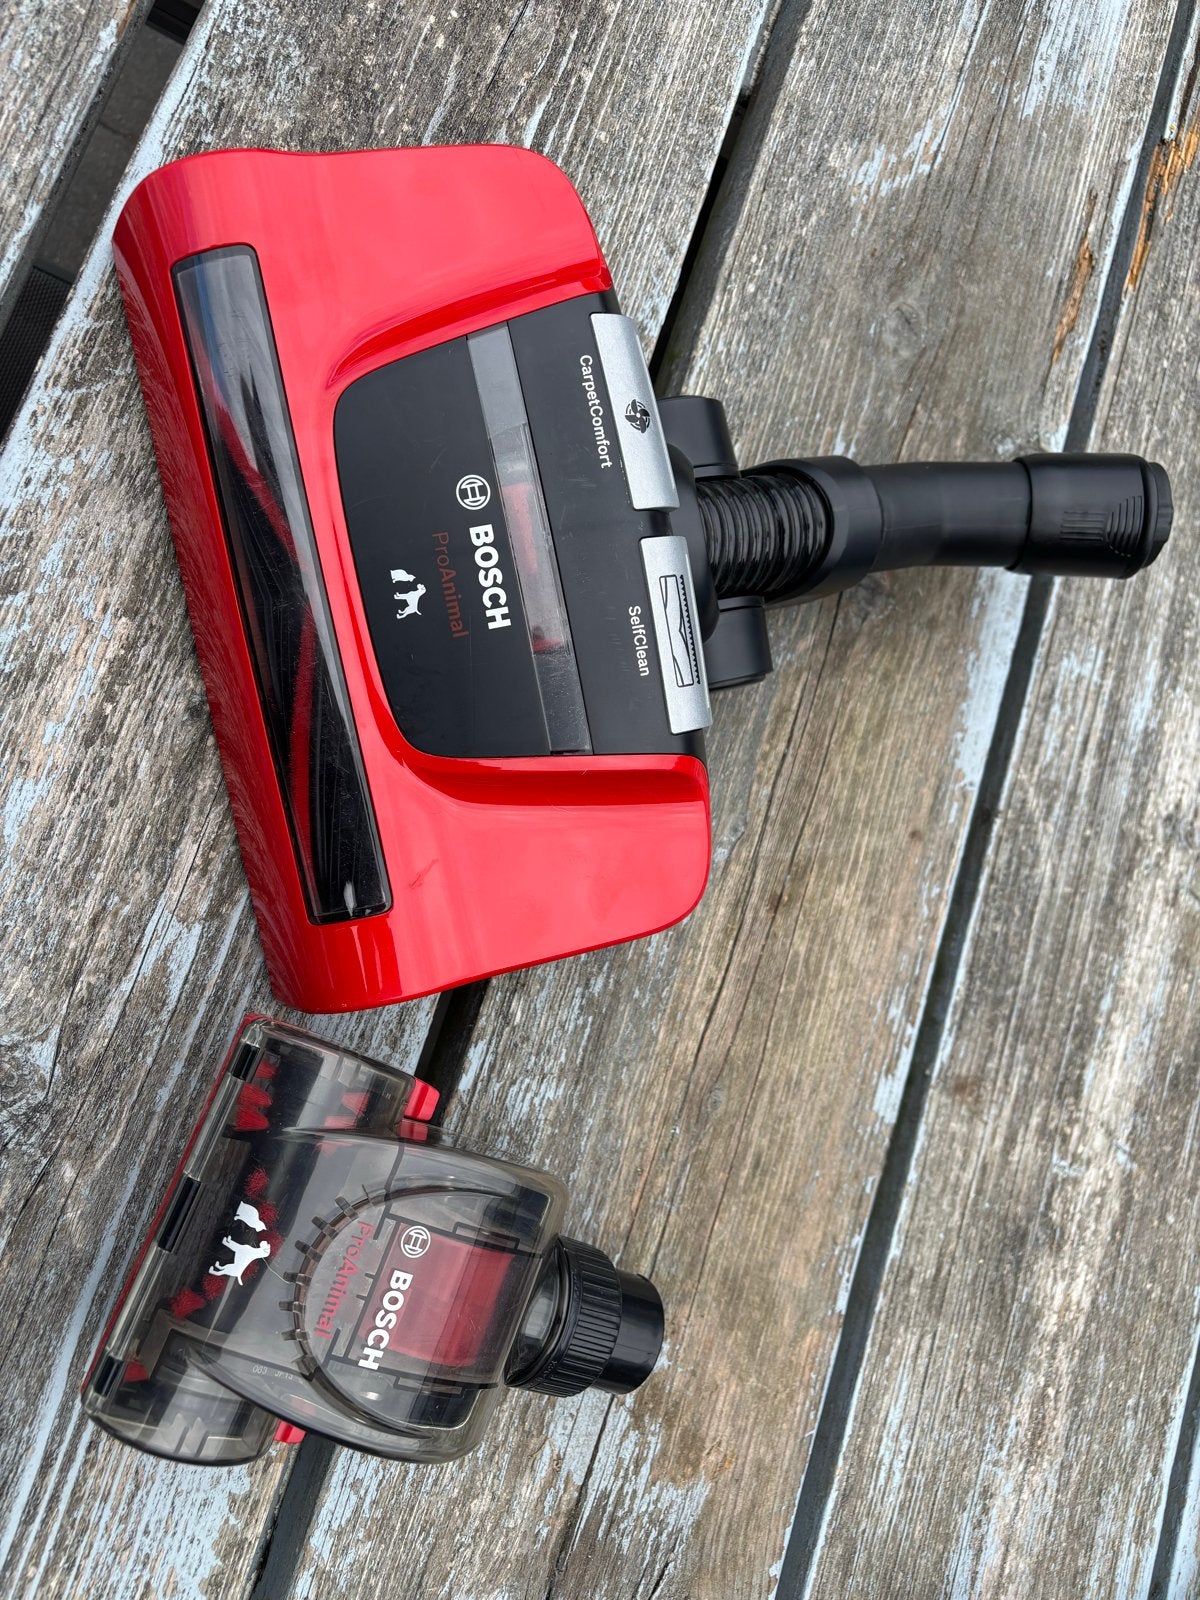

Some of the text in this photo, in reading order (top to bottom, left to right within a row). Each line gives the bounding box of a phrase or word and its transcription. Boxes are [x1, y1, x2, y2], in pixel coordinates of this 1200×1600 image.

[579, 354, 612, 469] CarpetComfort
[432, 532, 469, 638] ProAnimal
[469, 524, 511, 630] BOSCH
[628, 605, 650, 676] SelfClean
[314, 1221, 375, 1339] ProAnimal
[358, 1270, 413, 1370] BOSCH
